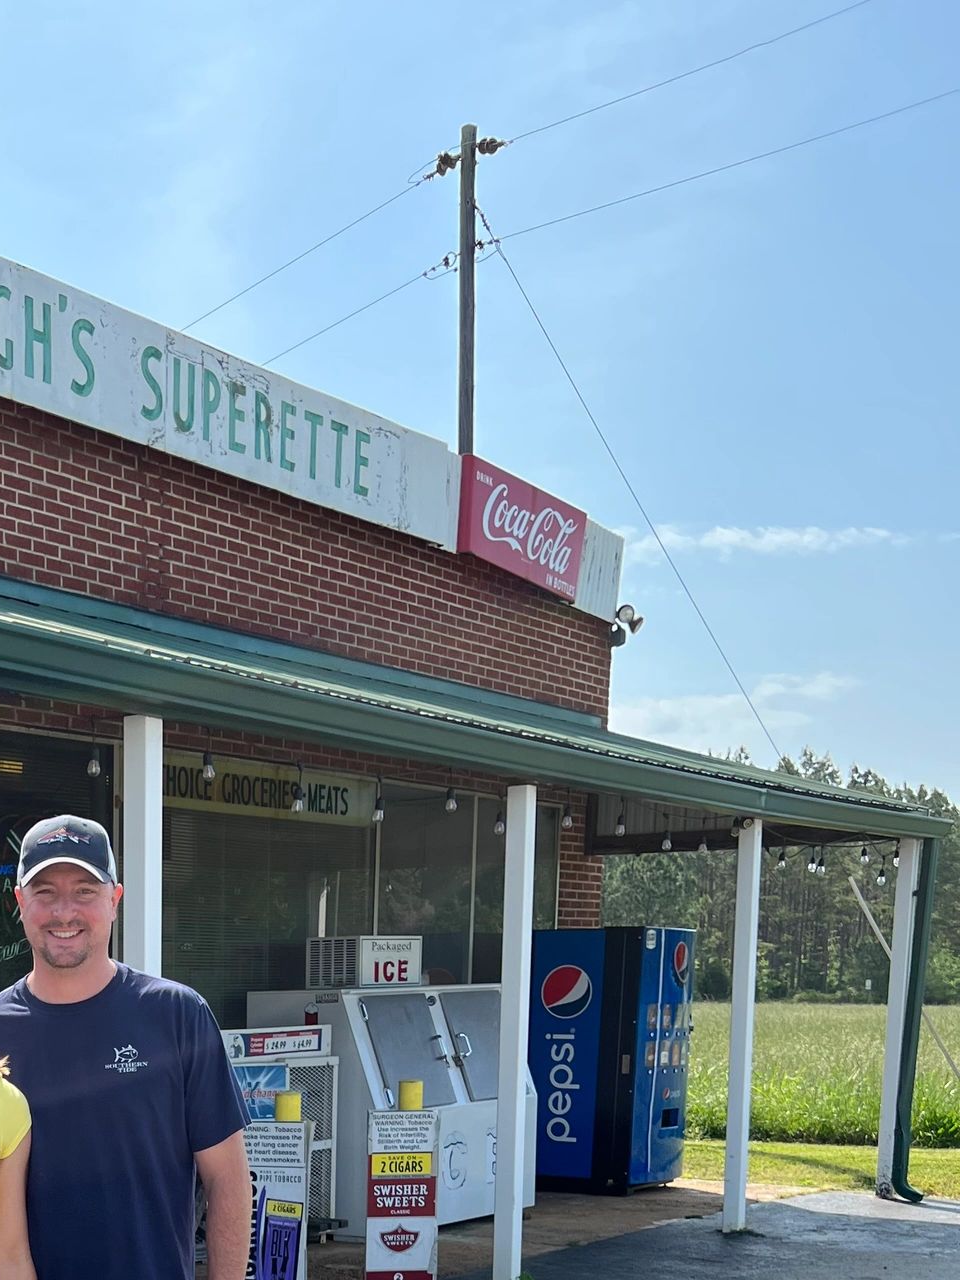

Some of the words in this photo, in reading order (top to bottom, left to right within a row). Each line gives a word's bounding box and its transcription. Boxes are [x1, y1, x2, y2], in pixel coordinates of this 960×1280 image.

[140, 346, 372, 497] SUPERETTE
[477, 471, 493, 487] DRINK
[483, 484, 579, 575] Coca-Cola
[546, 573, 553, 587] IN
[554, 577, 576, 598] BOTTLES
[162, 765, 213, 801] HOICE
[308, 783, 349, 816] MEATS
[372, 942, 412, 953] Packaged
[374, 960, 409, 983] ICE
[546, 1033, 580, 1143] pepsi
[381, 1161, 387, 1173] 2
[389, 1161, 423, 1173] CIGARS
[260, 1175, 272, 1183] PIPE
[275, 1175, 302, 1183] TOBACCO
[374, 1184, 428, 1197] SWISHER
[376, 1196, 426, 1208] SWEETS
[278, 1205, 297, 1214] CIGARS
[384, 1234, 415, 1242] SWISHER
